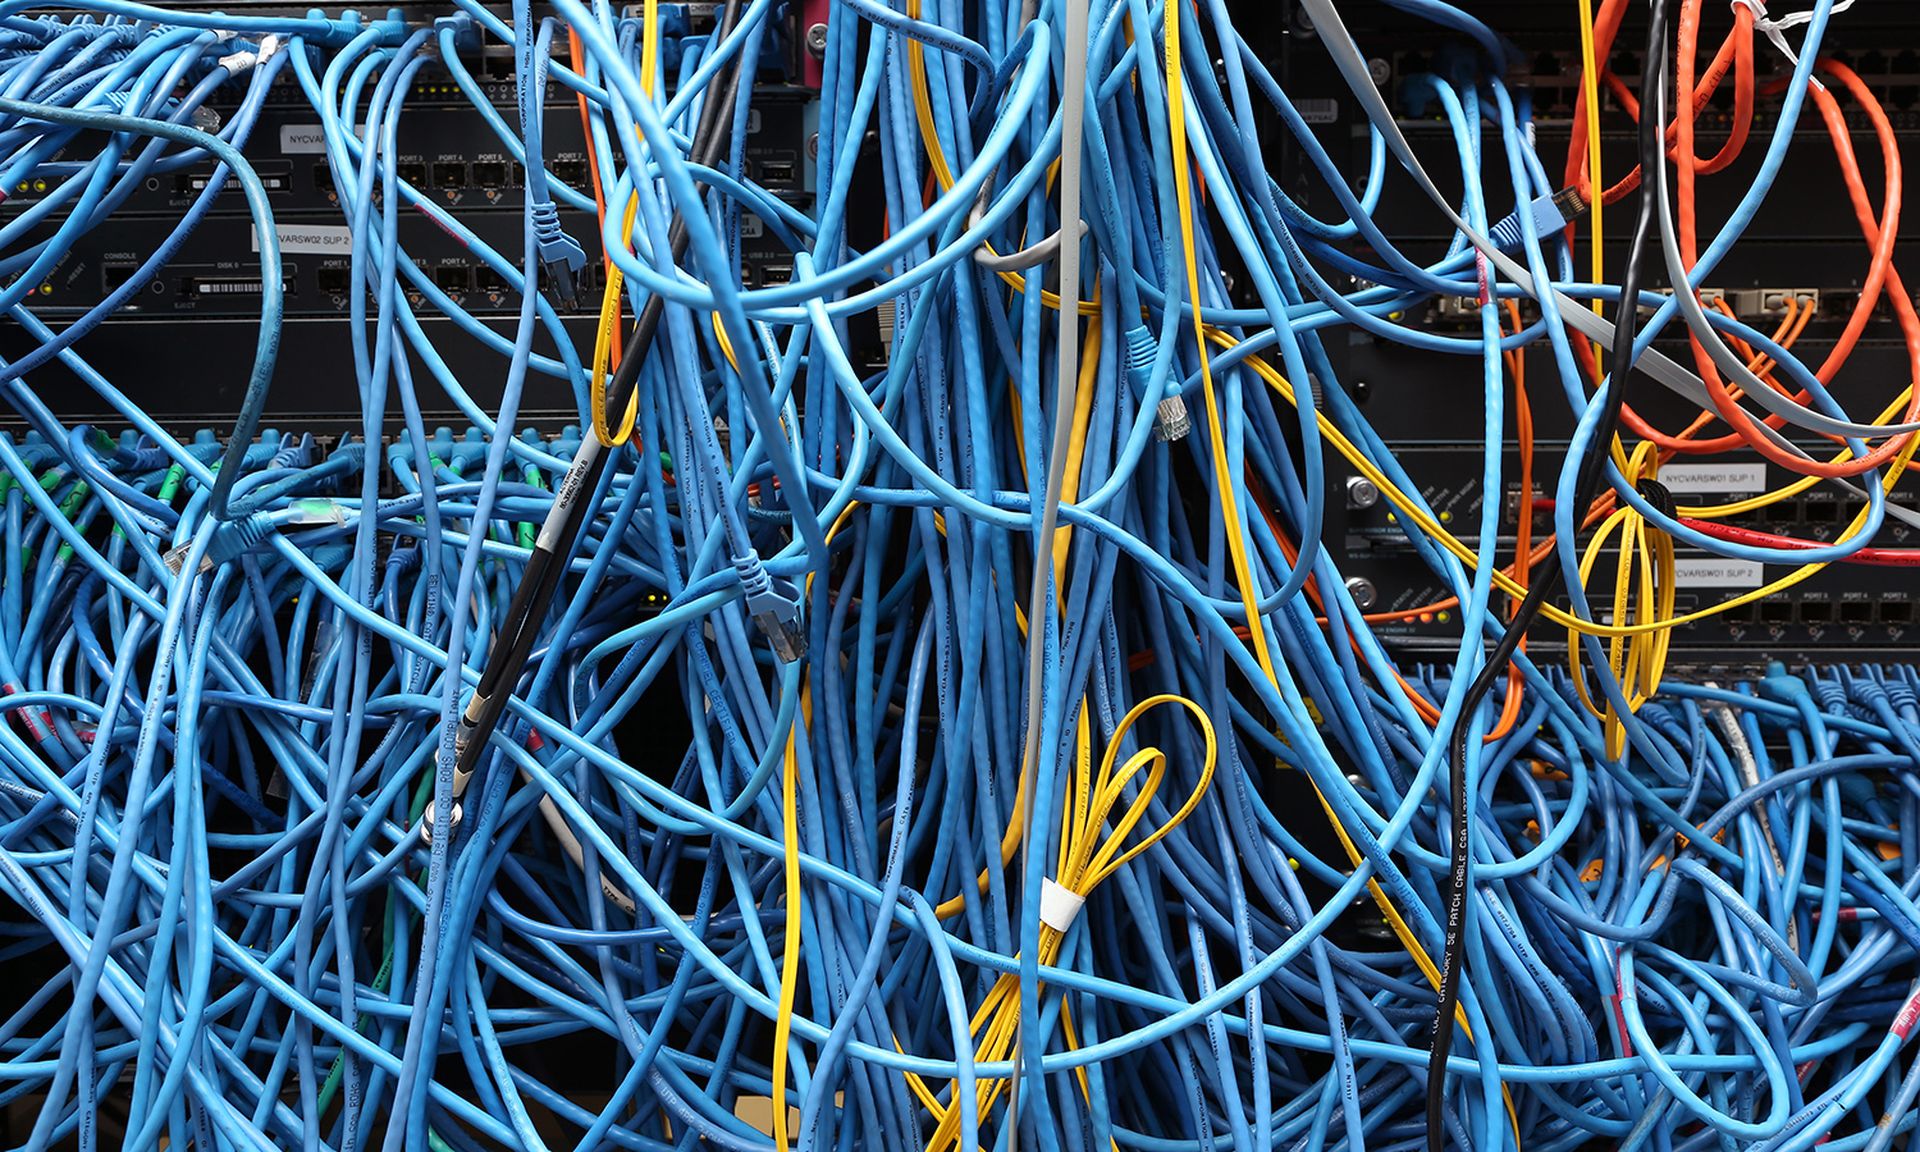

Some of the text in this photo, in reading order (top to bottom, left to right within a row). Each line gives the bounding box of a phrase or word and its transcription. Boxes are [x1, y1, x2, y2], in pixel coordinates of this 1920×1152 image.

[323, 236, 341, 244] SUP
[344, 237, 349, 245] 2
[1666, 475, 1726, 483] NYCVARSW01
[1730, 474, 1747, 482] SUP
[696, 641, 736, 746] CHANNEL CERTIFIED
[440, 689, 459, 784] ROHS COMPLIANT
[430, 788, 452, 884] www.belkin.com
[1458, 828, 1468, 850] CSA
[1357, 821, 1400, 884] CORPORATION
[1454, 855, 1466, 887] CABLE
[602, 886, 620, 903] TYPE
[1449, 890, 1464, 927] PATCH
[1732, 899, 1758, 928] HIGH
[1517, 942, 1529, 959] UTP
[1438, 951, 1455, 1003] CATEGORY
[350, 1083, 360, 1109] ROHS
[661, 1087, 677, 1106] UTP
[1196, 1086, 1208, 1138] CORPORATION
[82, 1110, 92, 1151] CATEGORY
